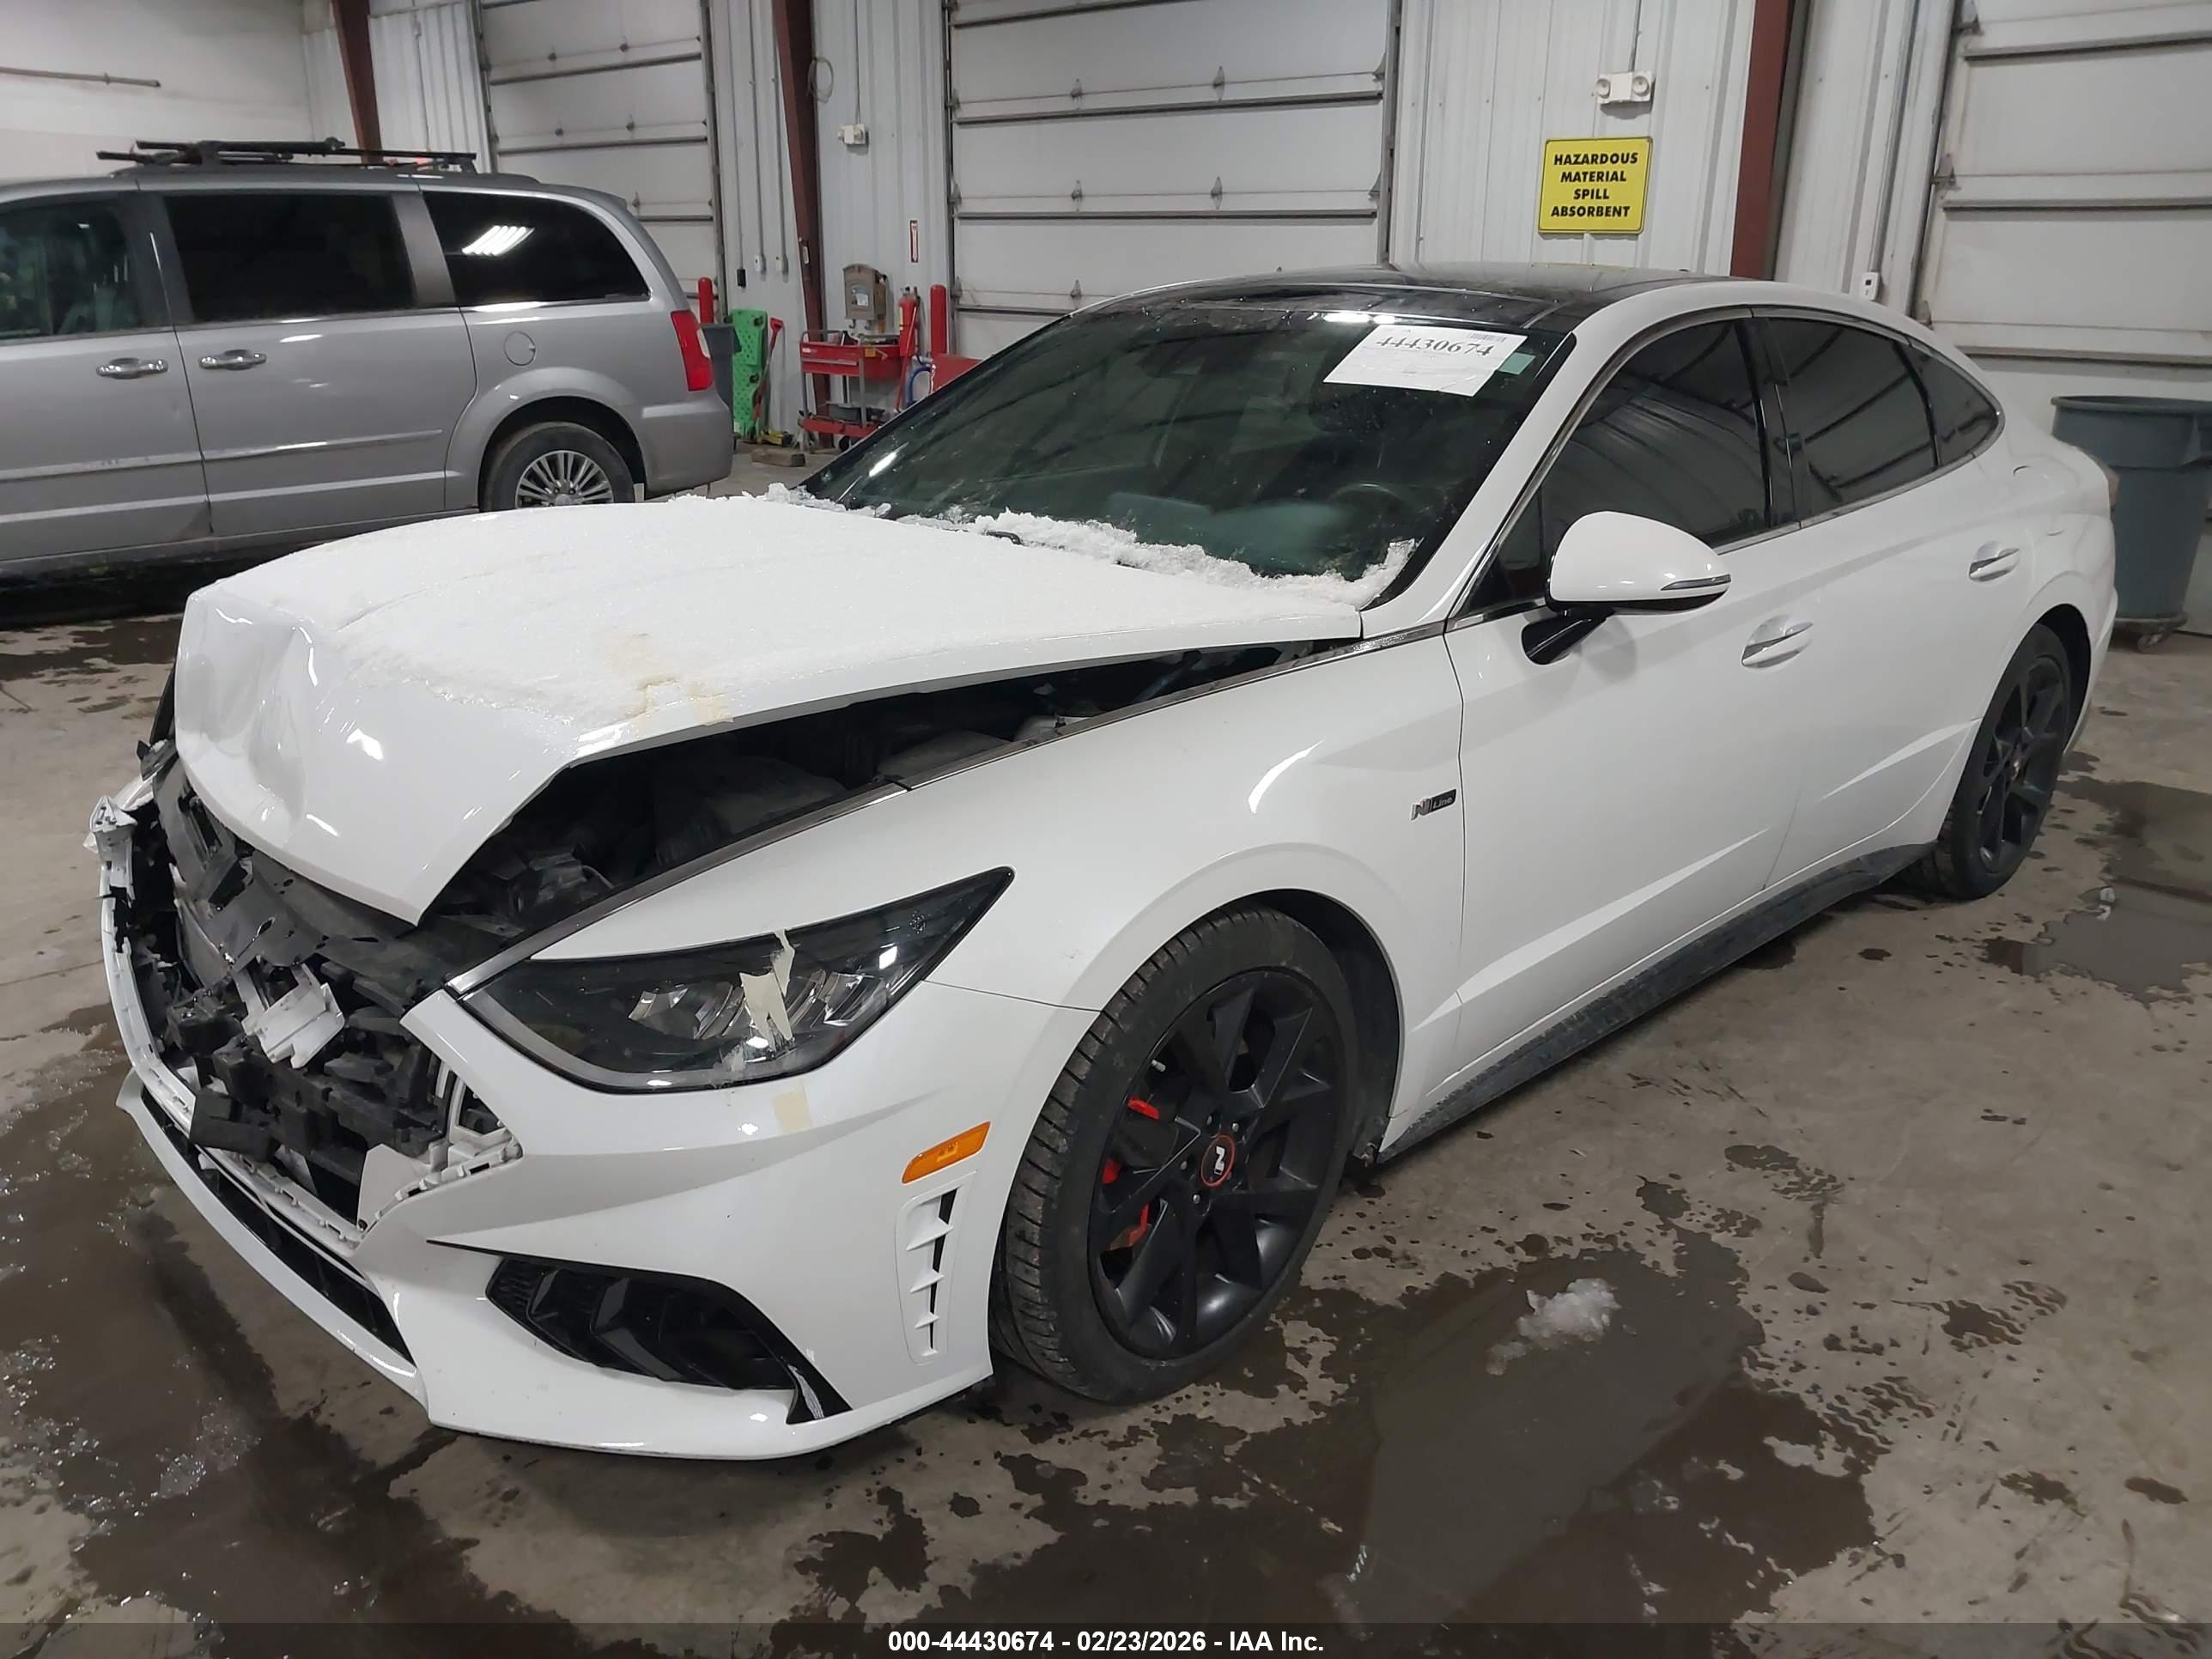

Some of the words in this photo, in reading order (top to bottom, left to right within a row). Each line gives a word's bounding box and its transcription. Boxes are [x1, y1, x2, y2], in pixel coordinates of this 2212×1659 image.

[1553, 152, 1638, 166] HAZARDOUS
[1560, 170, 1626, 183] MATERIAL
[1573, 188, 1610, 200] SPILL
[1551, 205, 1631, 217] ABSORBENT
[1376, 335, 1496, 357] 44430674
